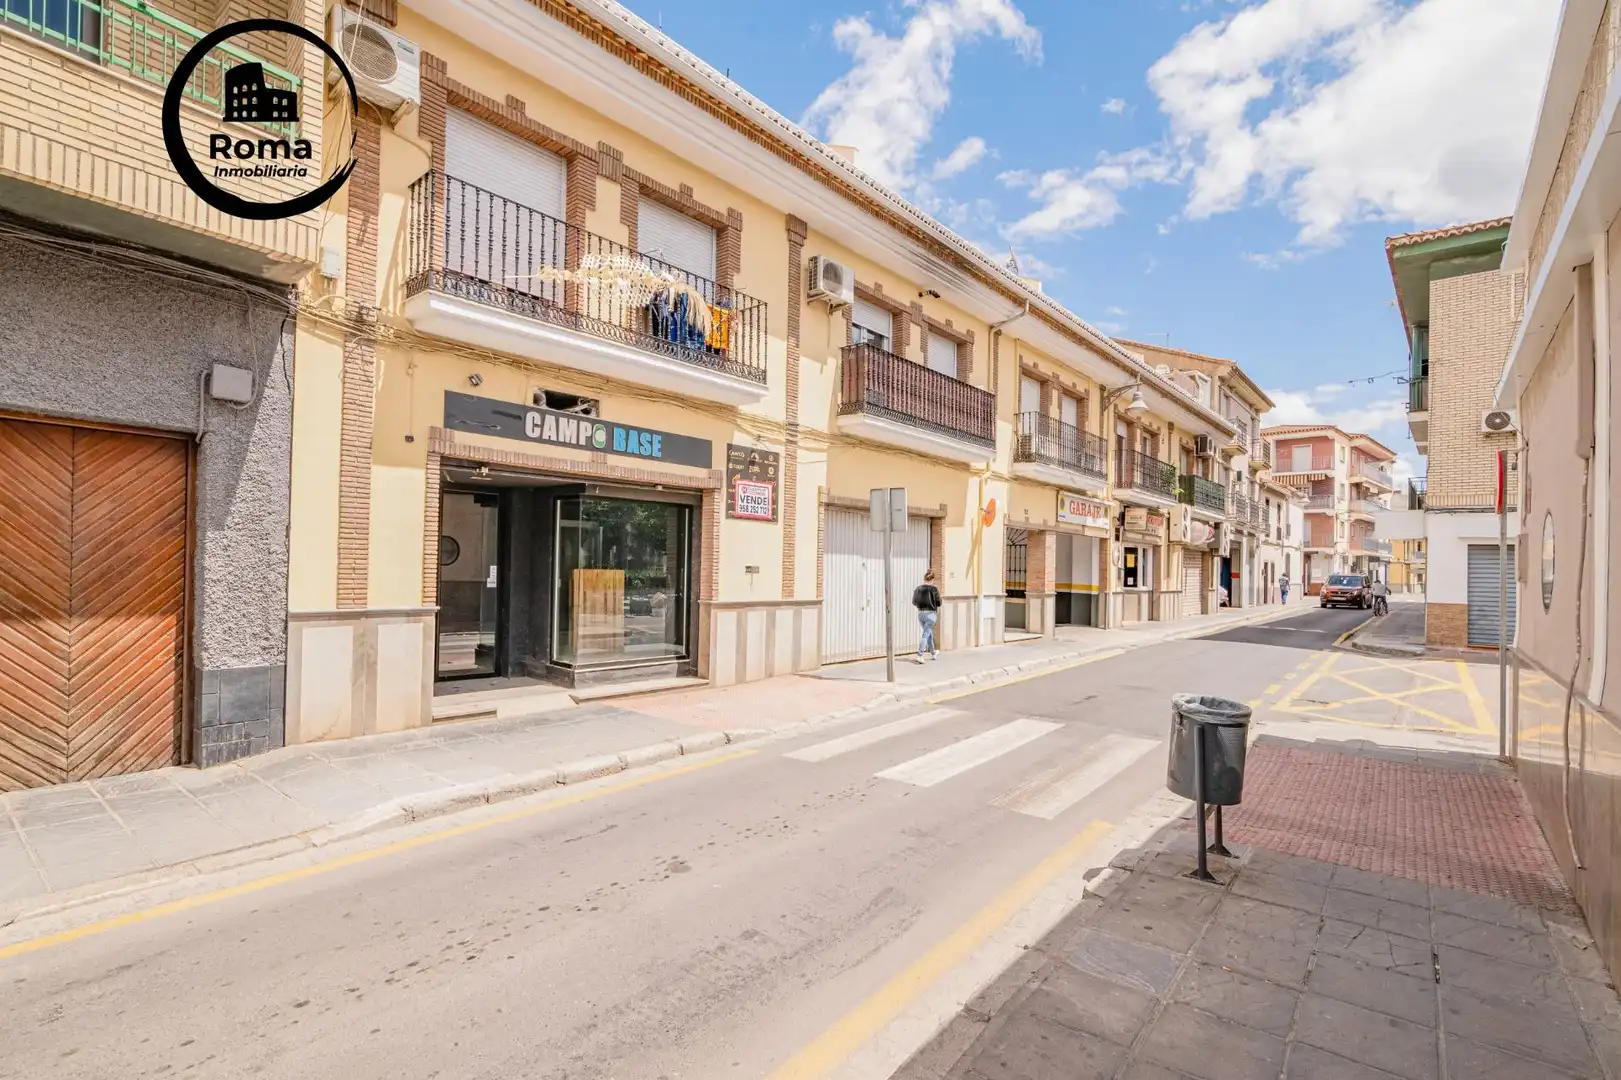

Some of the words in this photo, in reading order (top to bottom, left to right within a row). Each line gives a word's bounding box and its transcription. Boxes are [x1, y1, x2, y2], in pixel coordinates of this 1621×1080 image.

[525, 411, 606, 449] CAMPO
[613, 427, 662, 458] BASE
[739, 494, 767, 506] VENDE
[1069, 500, 1101, 519] GARAJE
